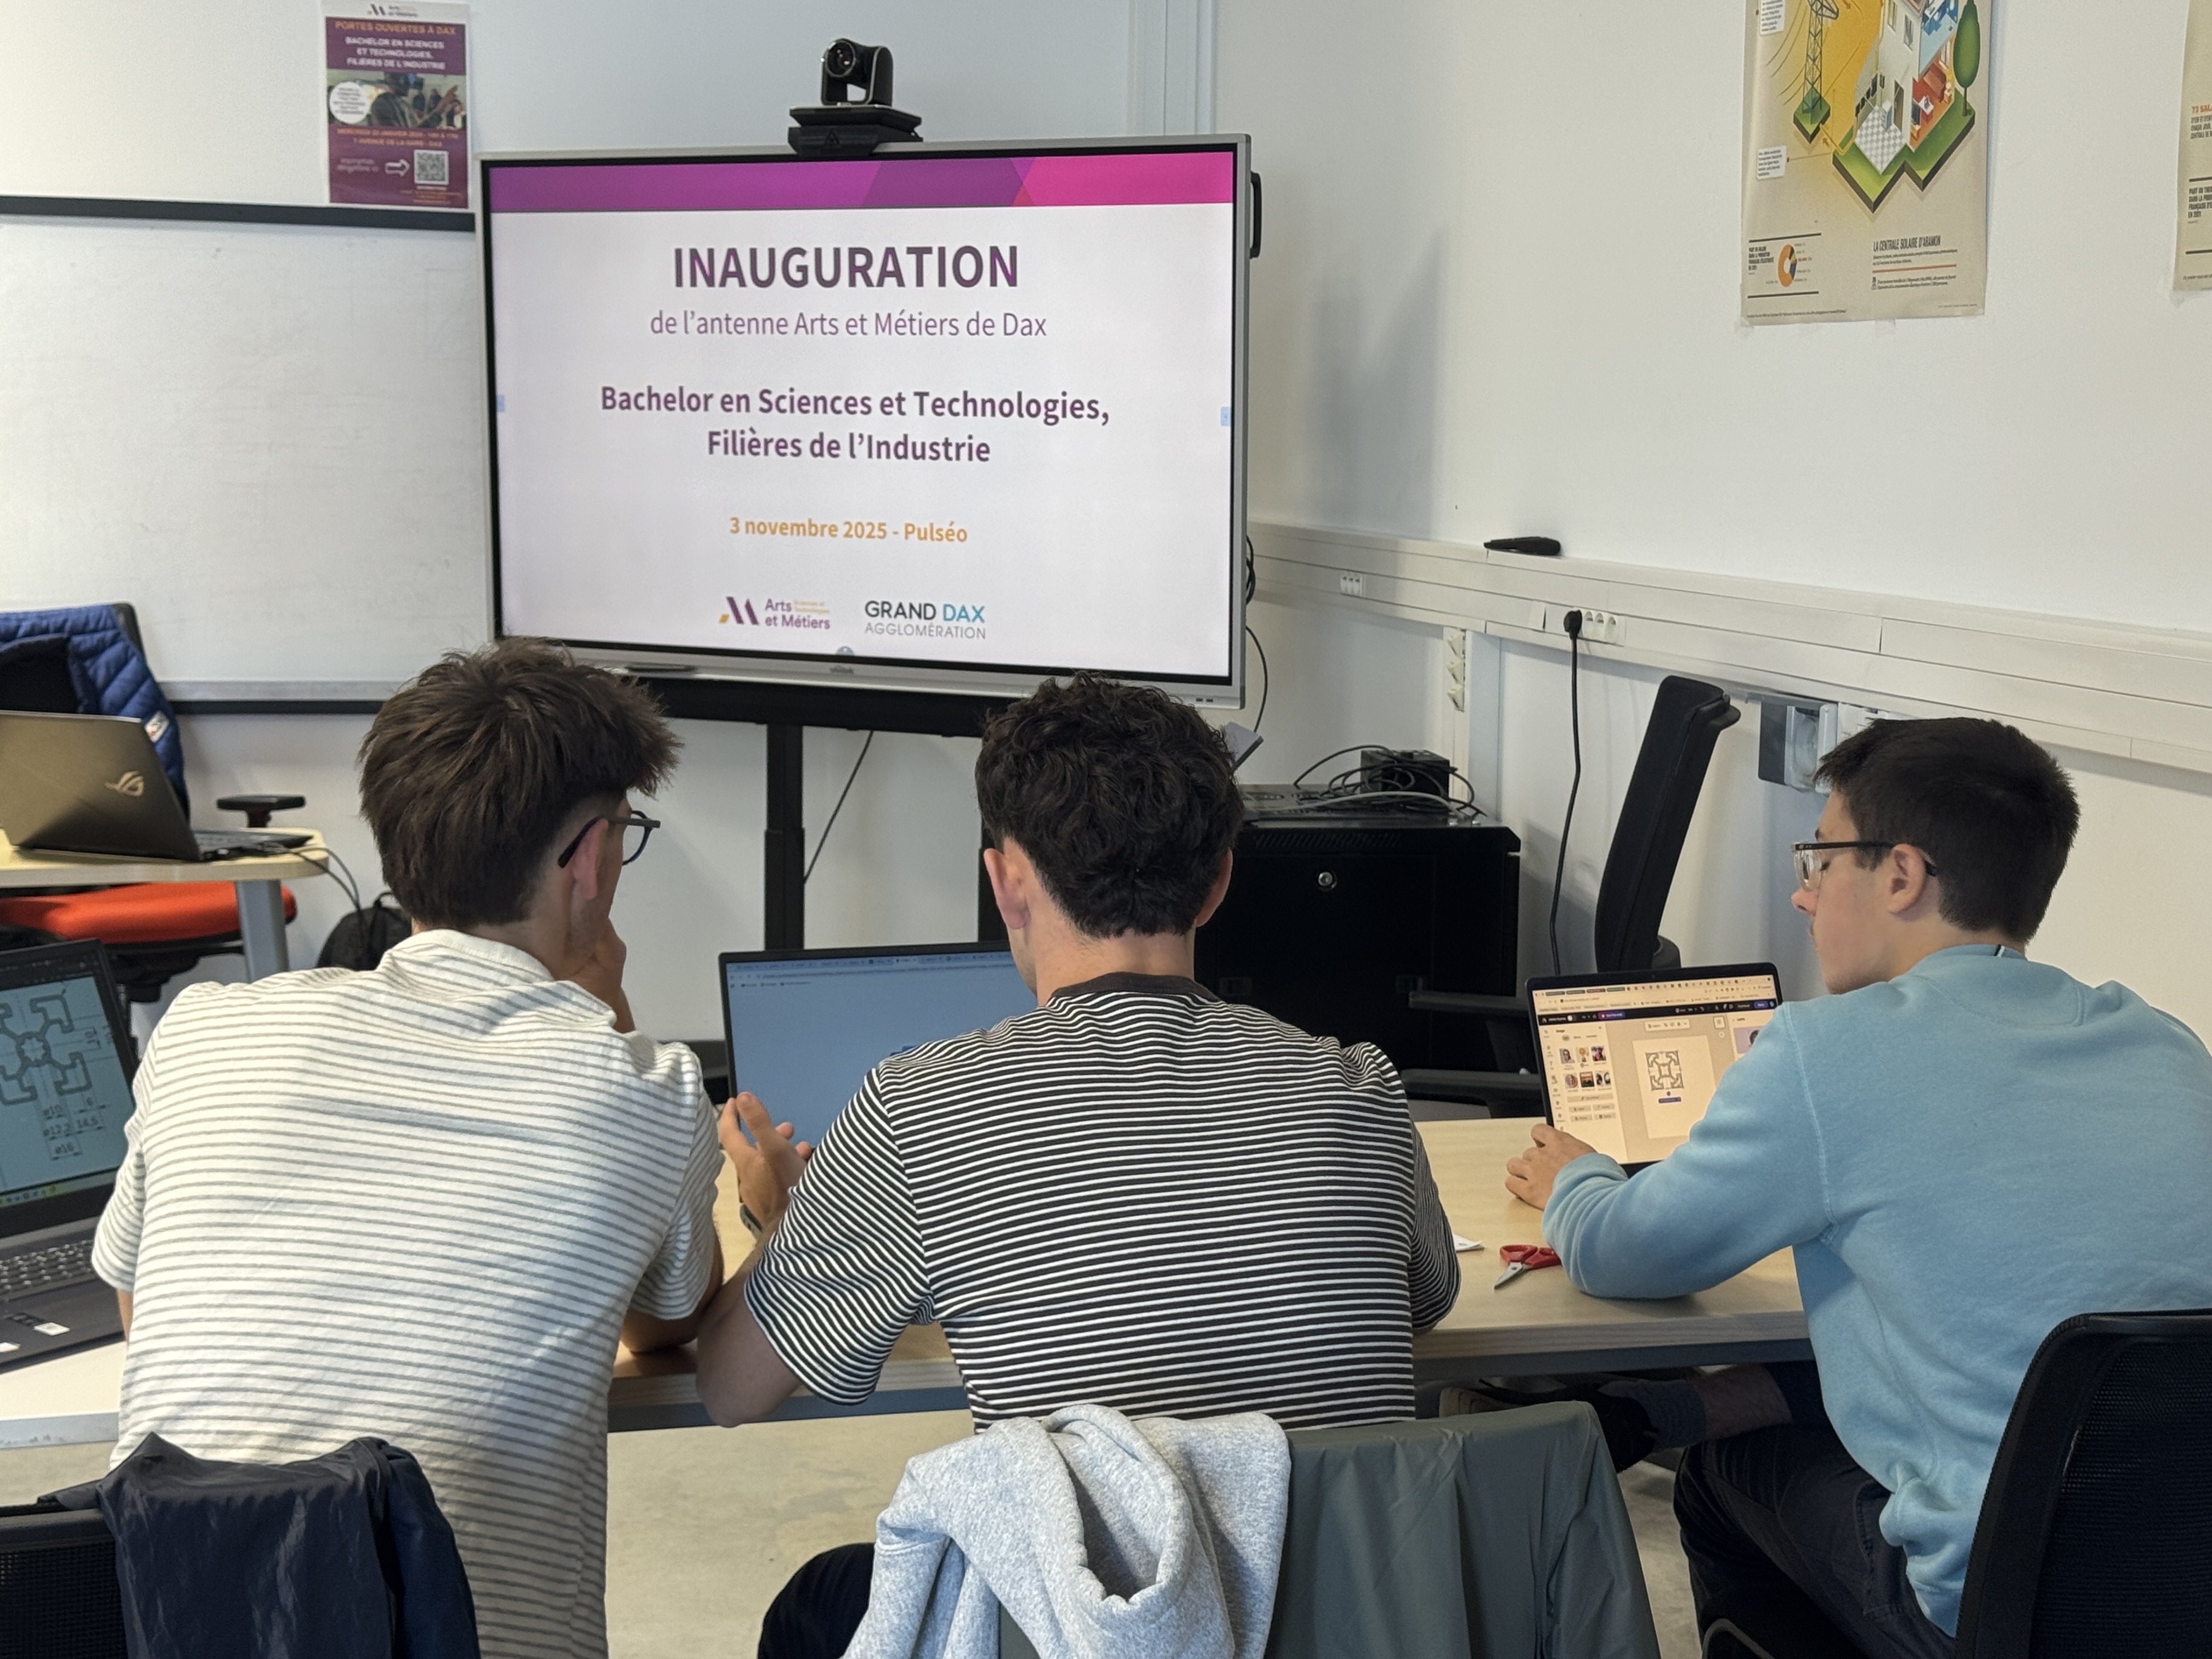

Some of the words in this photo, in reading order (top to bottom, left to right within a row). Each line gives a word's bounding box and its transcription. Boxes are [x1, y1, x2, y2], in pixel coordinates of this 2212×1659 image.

[345, 36, 390, 46] BACHELOR
[405, 40, 444, 49] SCIENCES
[674, 245, 1018, 289] INAUGURATION
[651, 309, 677, 334] de
[683, 310, 788, 336] l’antenne
[794, 313, 839, 335] Arts
[845, 314, 867, 336] et
[875, 309, 960, 336] Métiers
[966, 311, 995, 336] de
[1003, 313, 1047, 336] Dax
[602, 386, 714, 413] Bachelor
[720, 393, 751, 413] en
[758, 387, 872, 416] Sciences
[879, 391, 906, 416] et
[913, 390, 1109, 427] Technologies,
[708, 426, 803, 458] Filières
[809, 432, 842, 459] de
[849, 432, 991, 462] l’Industrie
[730, 517, 740, 534] 3
[744, 518, 839, 538] novembre
[843, 521, 887, 539] 2025
[905, 521, 968, 543] Pulséo
[765, 597, 792, 612] Arts
[865, 600, 936, 622] GRAND
[943, 603, 985, 623] DAX
[765, 615, 778, 627] et
[781, 614, 831, 630] Métiers
[865, 621, 986, 640] AGGLOMÉRATION
